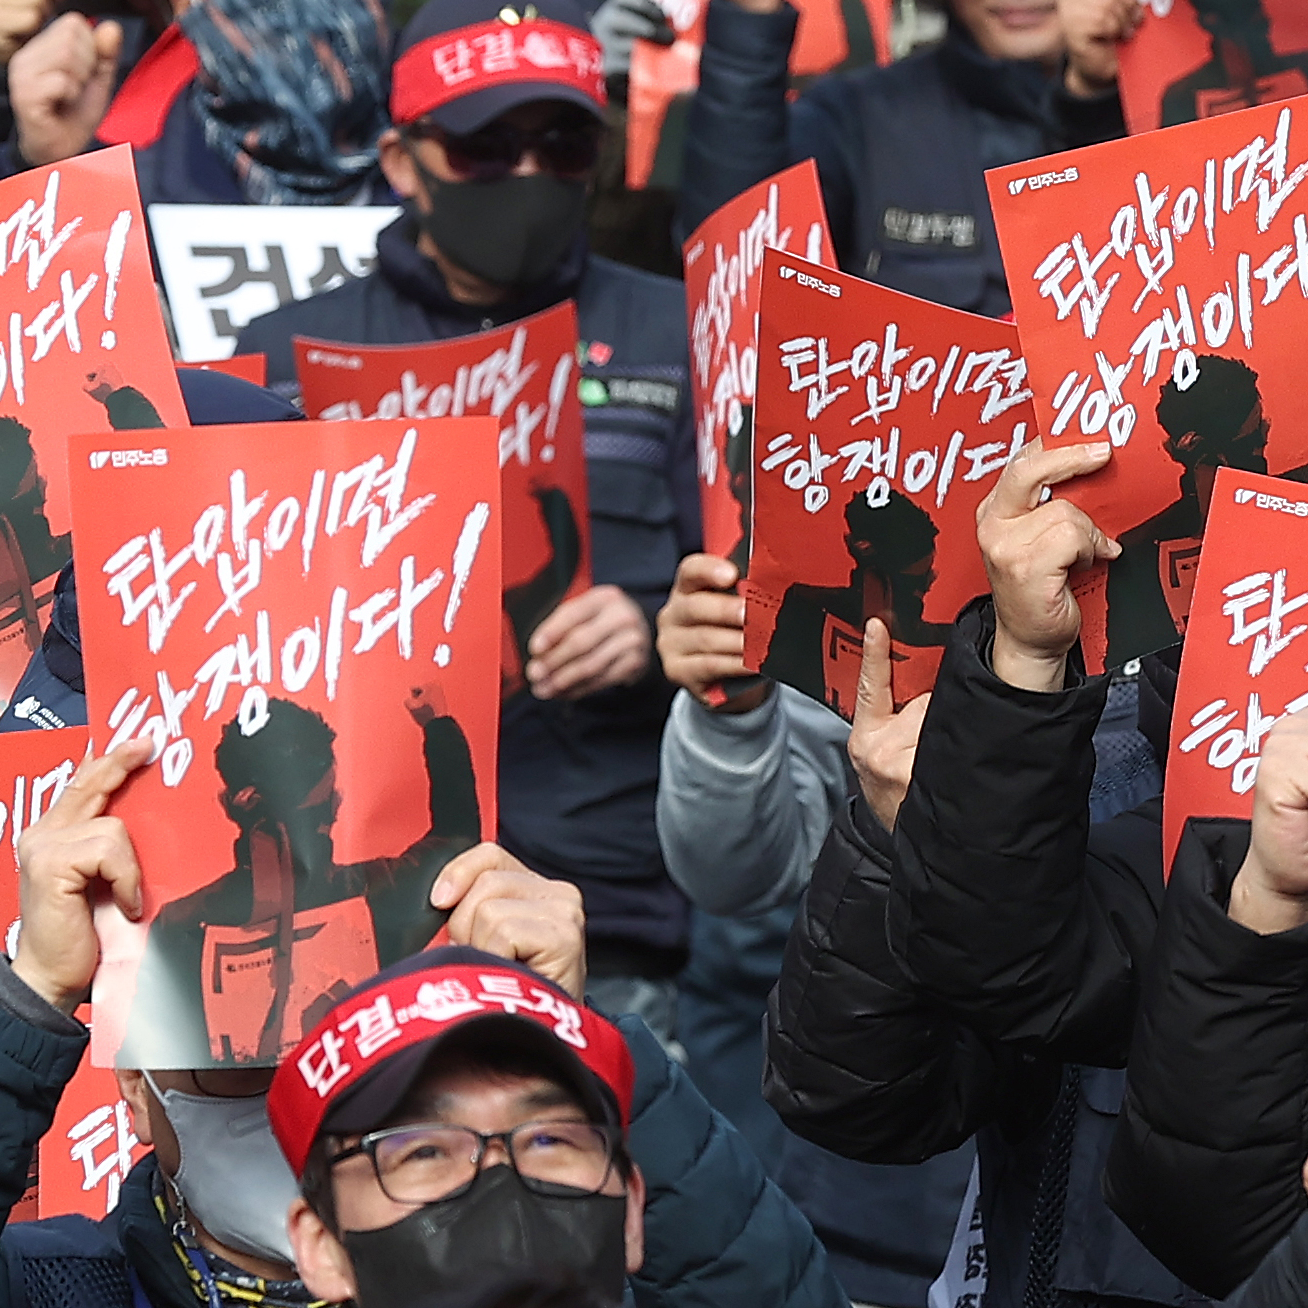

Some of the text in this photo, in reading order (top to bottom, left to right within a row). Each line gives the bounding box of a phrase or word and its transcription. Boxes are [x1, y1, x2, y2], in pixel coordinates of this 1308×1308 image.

[432, 31, 516, 89] 단결
[1027, 166, 1079, 191] 민주노총
[796, 271, 841, 299] 민주노총
[779, 322, 1033, 428] 탄압이면
[110, 446, 169, 469] 민주노총
[103, 428, 436, 654] 탄압이면
[103, 498, 491, 787] 항쟁이다!
[296, 972, 588, 1099] 단결 투쟁
